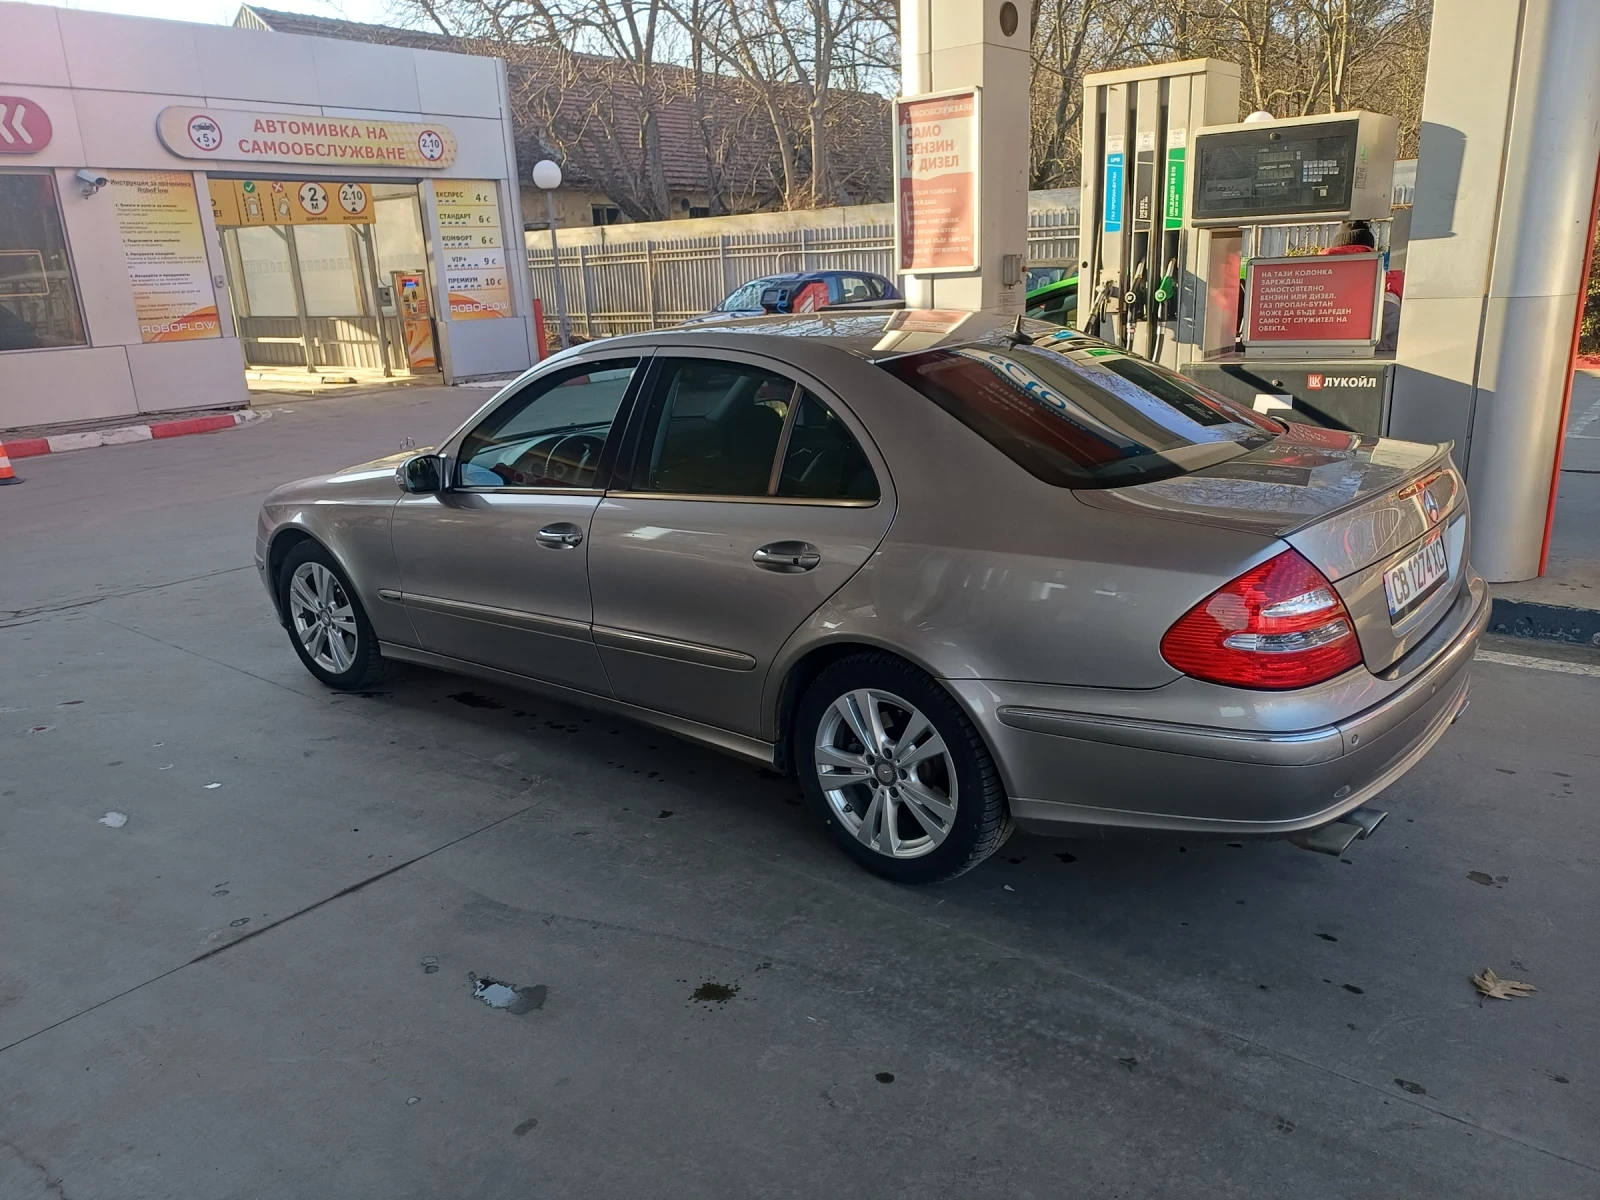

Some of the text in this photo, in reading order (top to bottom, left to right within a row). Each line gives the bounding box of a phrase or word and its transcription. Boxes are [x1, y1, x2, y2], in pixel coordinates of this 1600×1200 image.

[254, 119, 388, 140] АВТОМИВКА НА
[907, 125, 941, 139] САМО
[203, 133, 209, 142] 5
[422, 139, 440, 148] 2.10
[906, 139, 954, 155] БЕНЗИН
[238, 139, 406, 160] САМООБСЛУЖВАНЕ
[907, 155, 959, 172] И ДИЗЕЛ
[308, 188, 318, 202] 2
[342, 191, 362, 200] 2.10
[476, 194, 481, 202] 4
[478, 215, 484, 223] 6
[482, 236, 487, 244] 6
[486, 278, 495, 286] 10
[1261, 285, 1324, 293] САМОСТОЯТЕЛНО
[450, 302, 509, 313] ROBOFLOW
[141, 321, 216, 334] ROBOFLOW
[1323, 376, 1377, 388] ЛУКОЙЛ
[1392, 540, 1444, 605] CB 1274 XC
